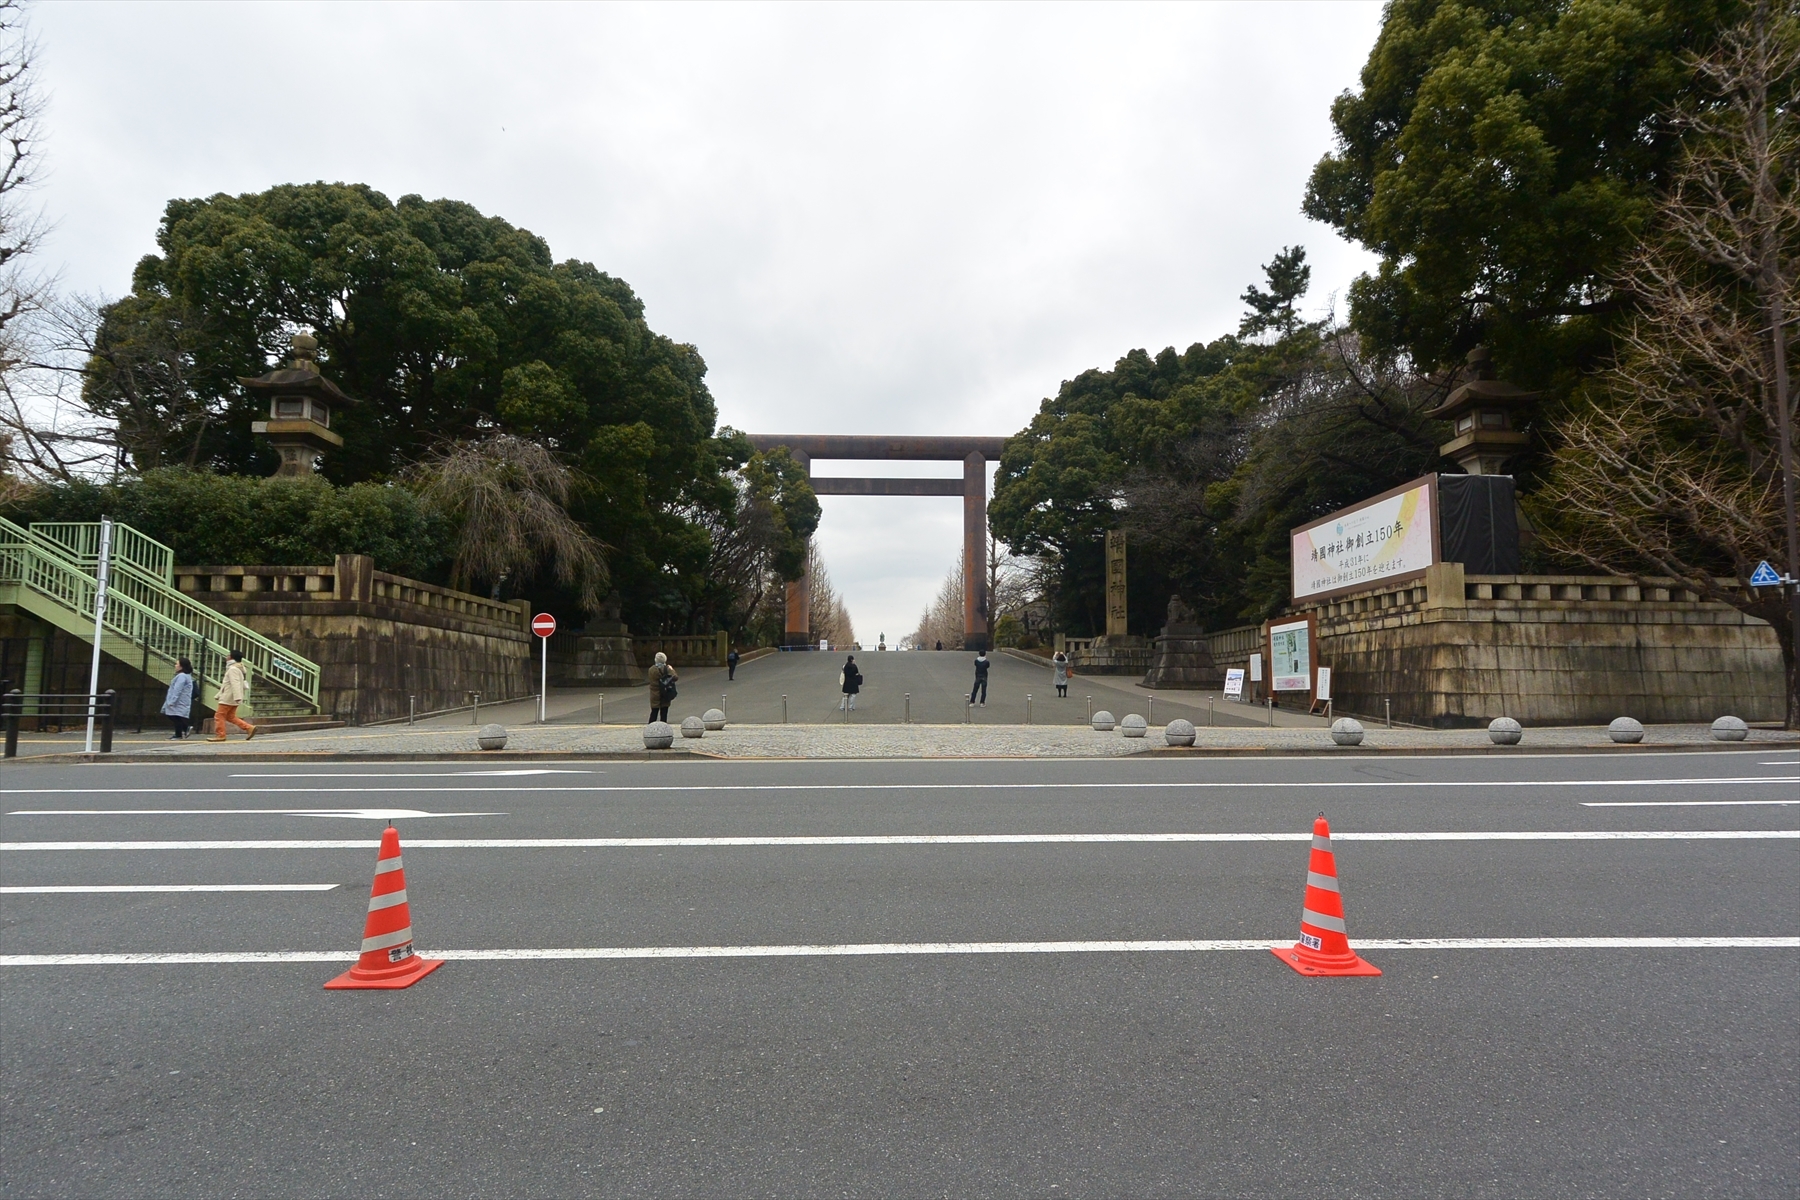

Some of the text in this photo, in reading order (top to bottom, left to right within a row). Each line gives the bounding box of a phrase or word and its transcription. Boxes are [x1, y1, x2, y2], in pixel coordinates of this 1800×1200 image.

[1311, 520, 1403, 562] 靖國神社御創立150年
[1339, 554, 1370, 570] 平成31年に
[1110, 533, 1126, 620] 靖國神社
